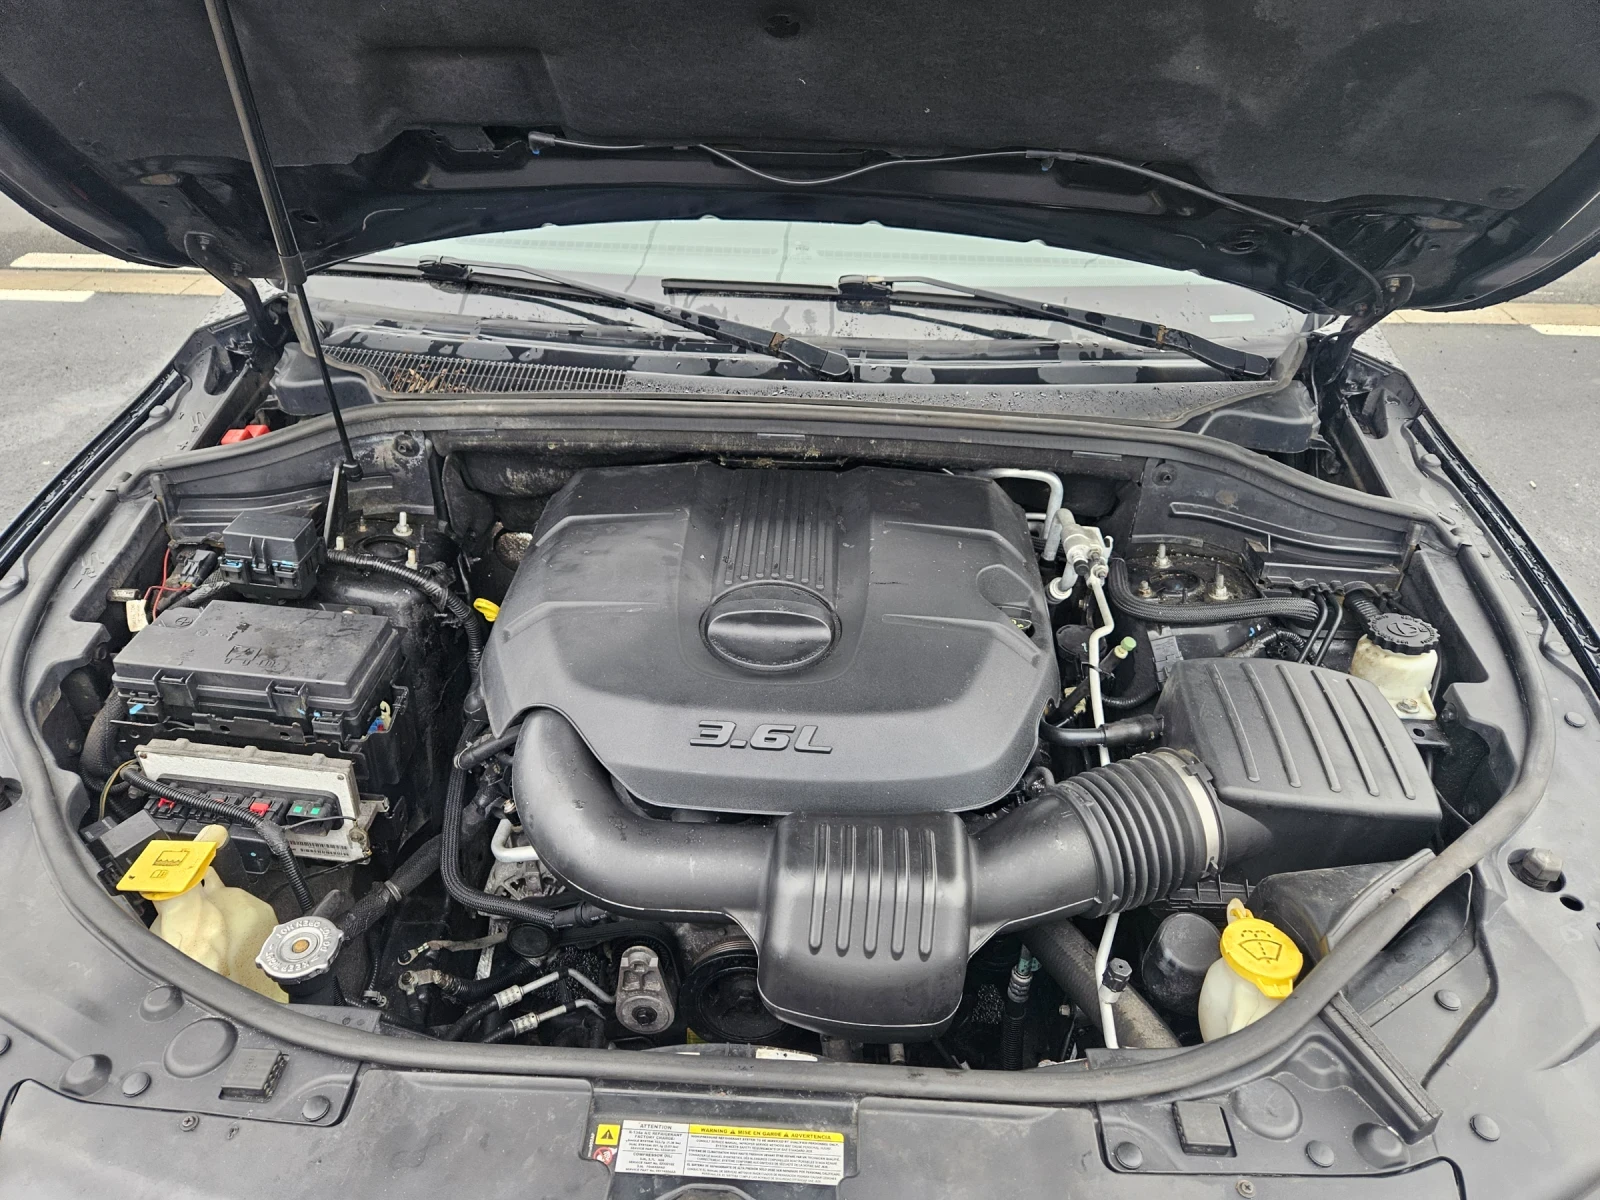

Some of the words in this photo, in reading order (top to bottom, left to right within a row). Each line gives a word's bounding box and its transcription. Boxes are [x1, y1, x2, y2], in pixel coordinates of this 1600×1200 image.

[690, 720, 833, 754] 3.6L
[296, 920, 320, 928] OPEN
[276, 924, 294, 938] HOT
[280, 961, 310, 972] KEEP
